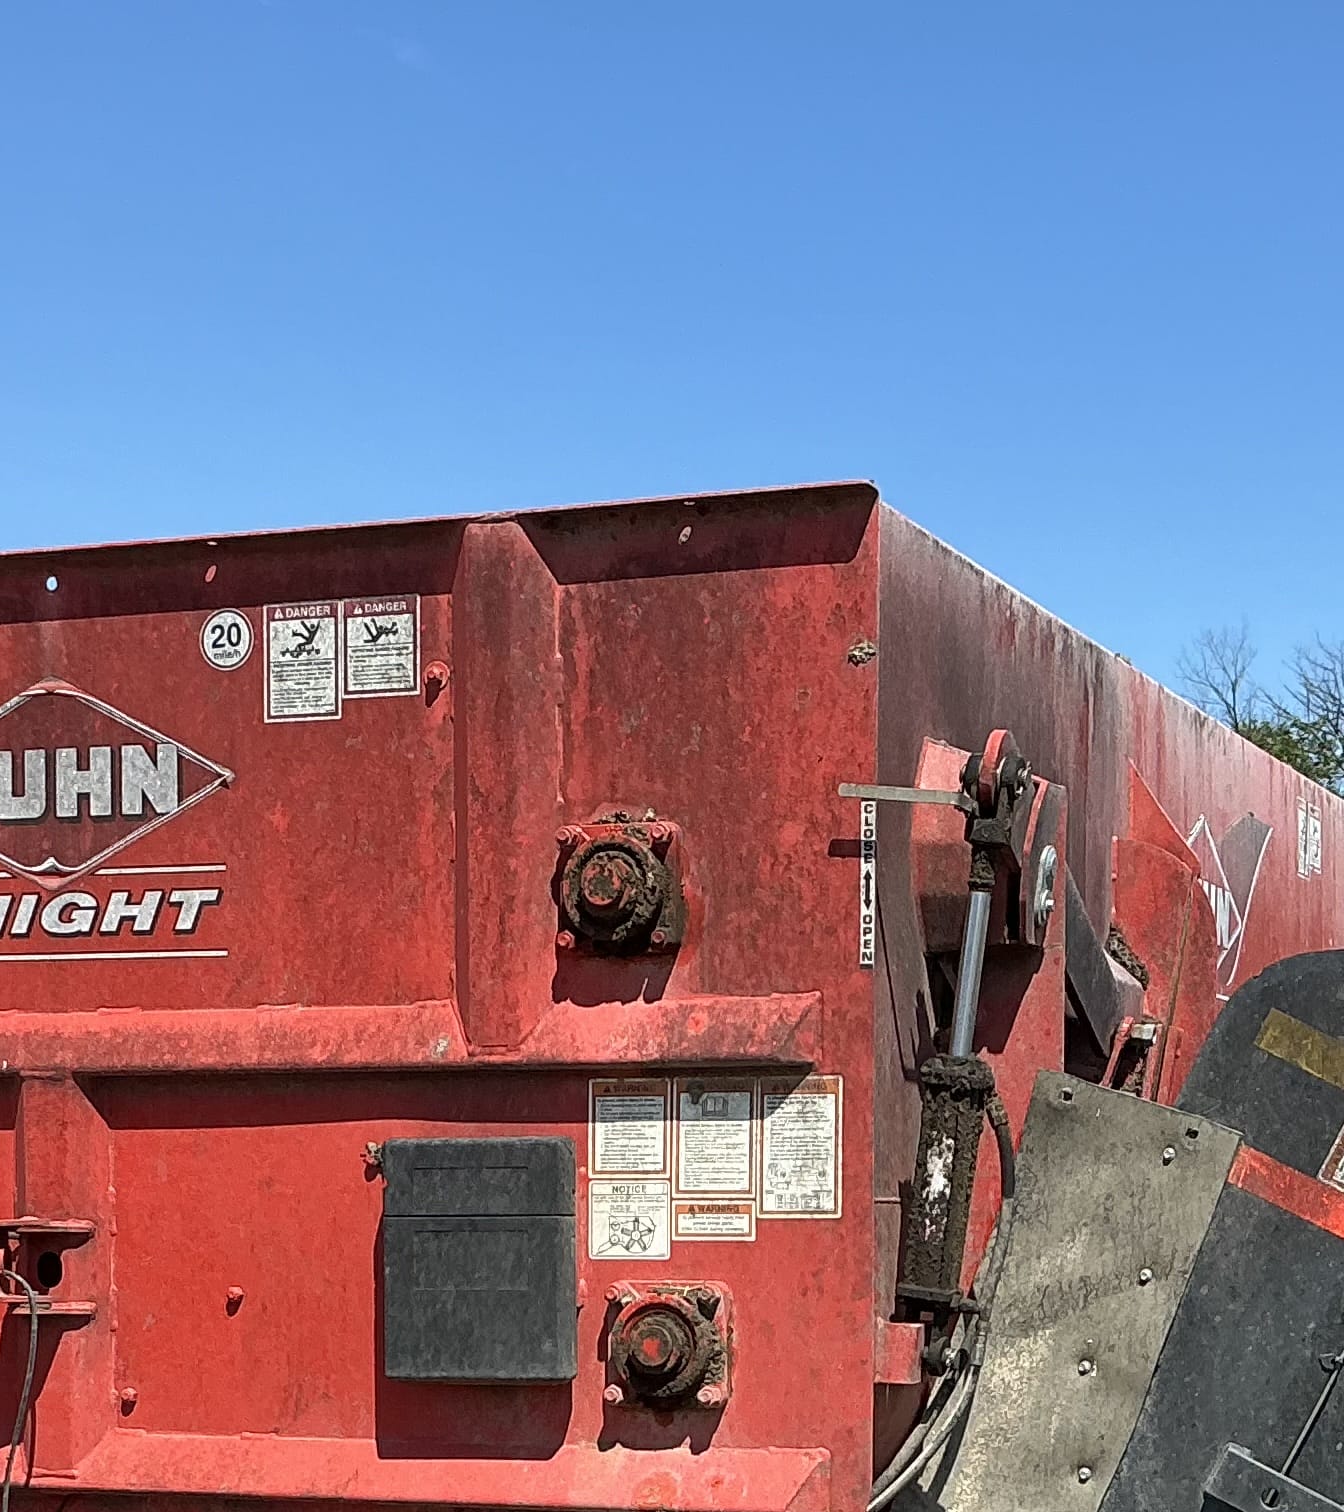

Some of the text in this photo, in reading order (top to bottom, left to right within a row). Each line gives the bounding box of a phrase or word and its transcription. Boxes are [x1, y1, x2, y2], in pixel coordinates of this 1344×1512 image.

[285, 605, 331, 618] DANGER
[365, 601, 407, 614] DANGER
[210, 622, 242, 649] 20
[863, 803, 875, 865] CLOSE
[861, 914, 873, 962] OPEN
[611, 1185, 647, 1195] NOTICE
